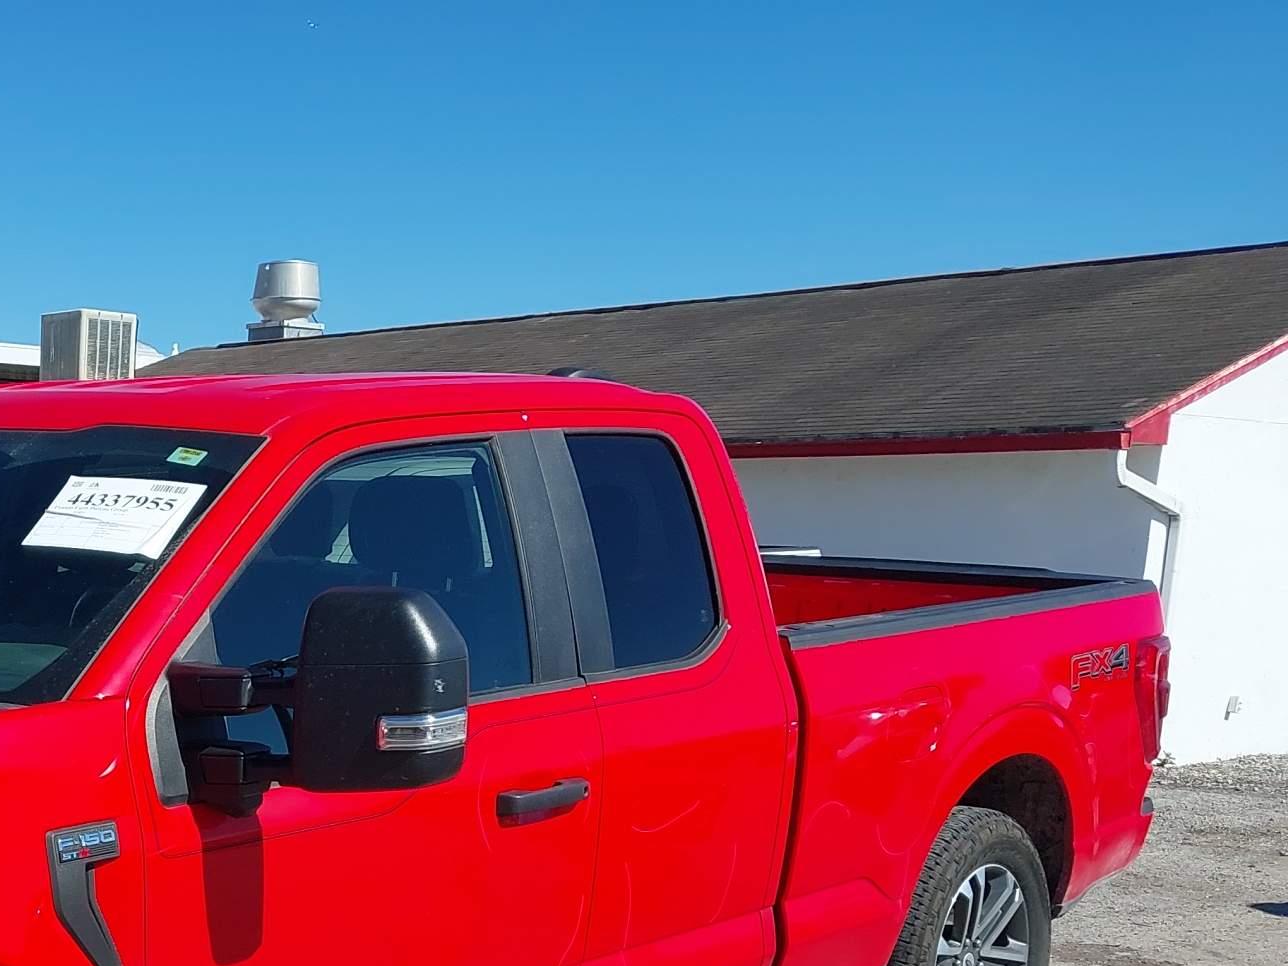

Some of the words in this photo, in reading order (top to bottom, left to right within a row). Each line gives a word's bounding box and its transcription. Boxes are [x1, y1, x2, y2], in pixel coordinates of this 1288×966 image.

[67, 493, 178, 511] 44337955
[1071, 643, 1129, 692] FX4
[58, 830, 116, 852] F-150
